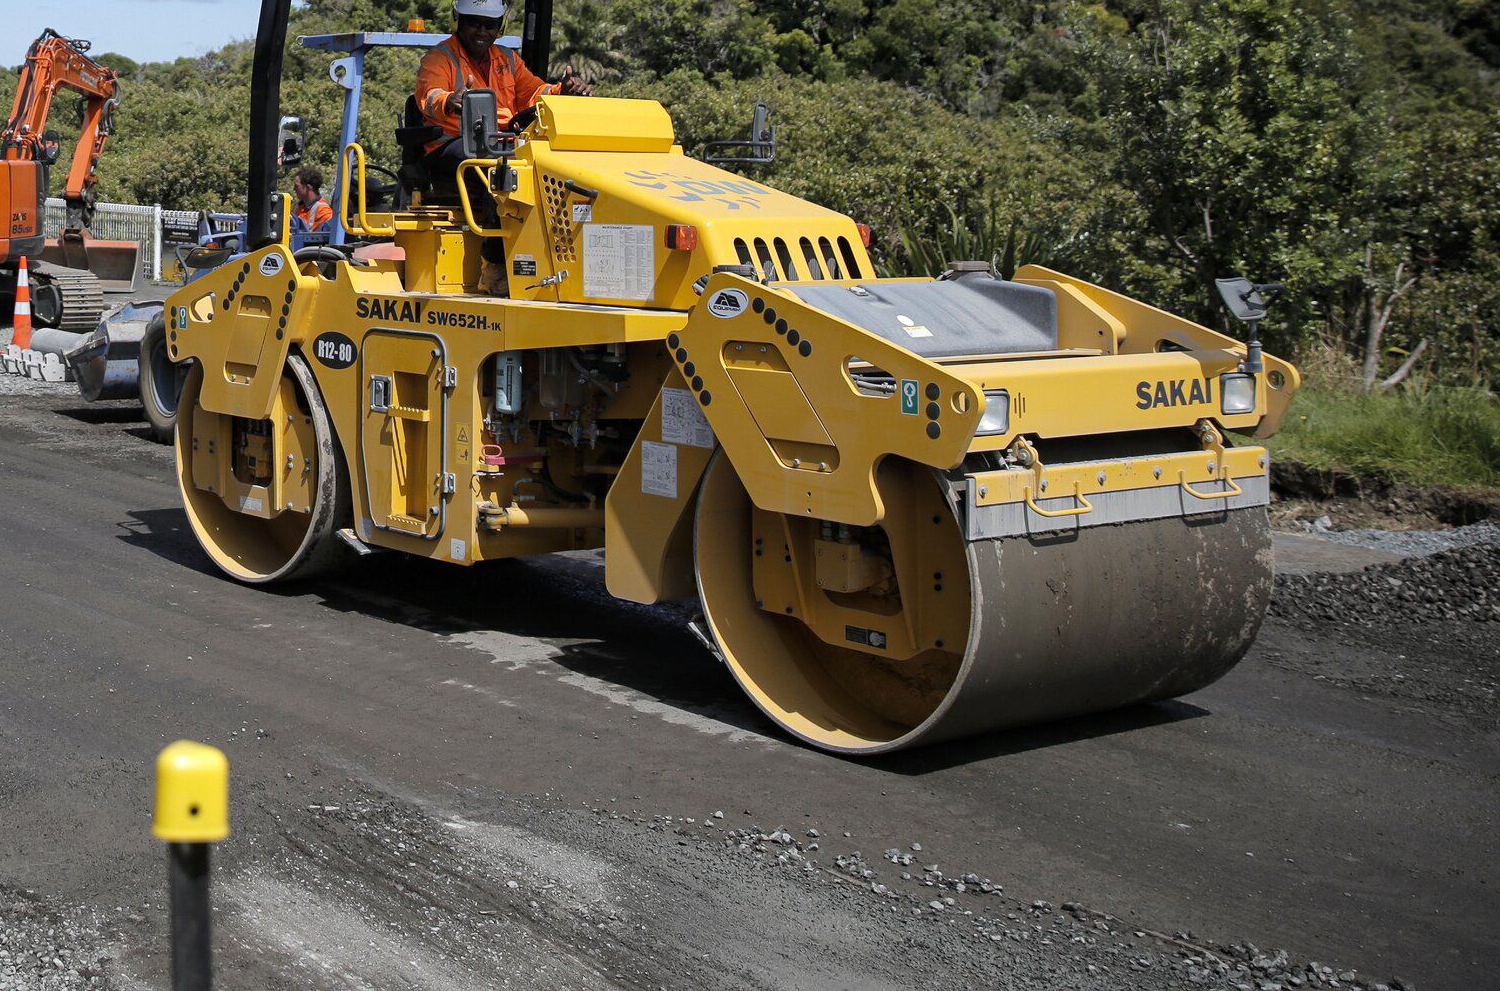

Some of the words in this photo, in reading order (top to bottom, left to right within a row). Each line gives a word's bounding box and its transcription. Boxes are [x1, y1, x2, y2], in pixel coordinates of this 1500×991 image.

[356, 297, 421, 323] SAKAI
[317, 340, 352, 362] R12-80
[1135, 378, 1212, 410] SAKAI
